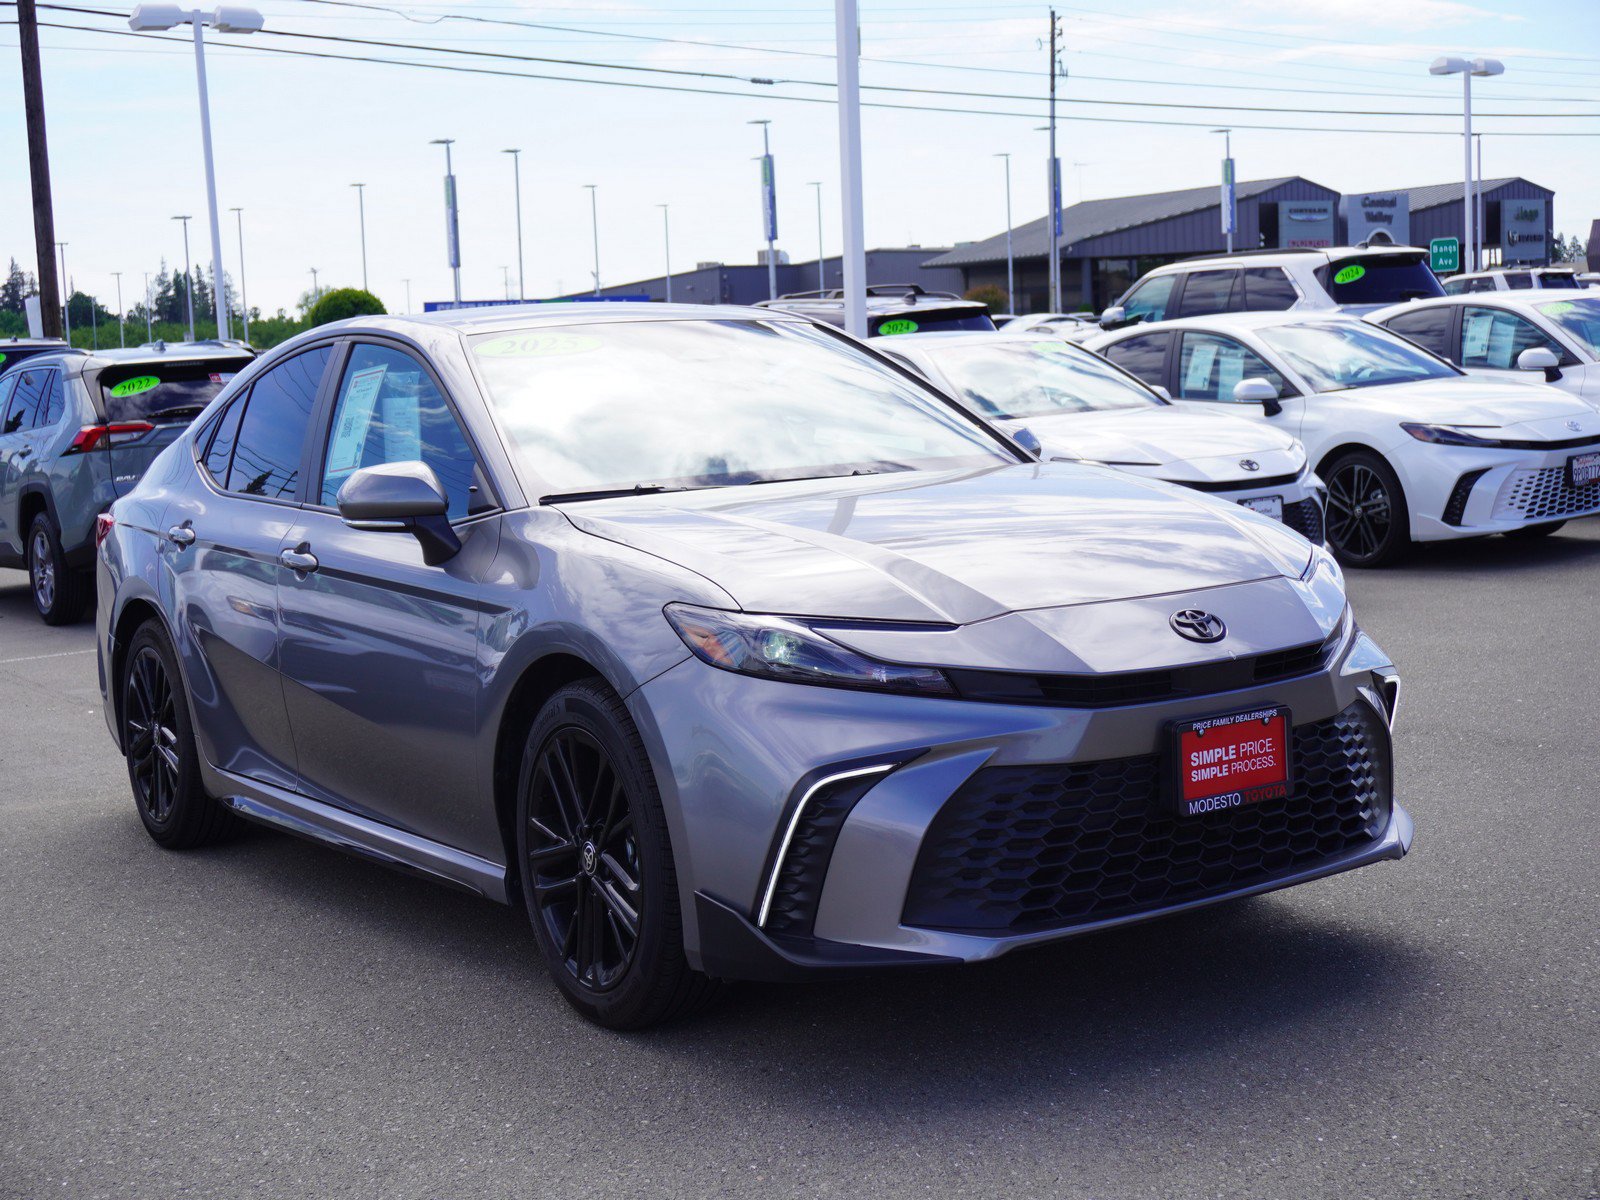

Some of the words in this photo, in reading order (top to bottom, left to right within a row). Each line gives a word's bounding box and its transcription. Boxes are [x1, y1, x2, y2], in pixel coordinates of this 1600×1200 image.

[1432, 244, 1457, 254] Bangs
[1438, 257, 1453, 266] Ave
[1340, 268, 1361, 283] 2024
[886, 320, 910, 334] 2024
[501, 336, 579, 354] 2025
[119, 378, 152, 397] 2022
[1192, 719, 1212, 731] PRICE
[1212, 716, 1235, 728] FAMILY
[1235, 709, 1278, 724] DEALERSHIPS
[1190, 745, 1237, 767] SIMPLE
[1239, 737, 1276, 758] PRICE.
[1191, 764, 1229, 782] SIMPLE
[1231, 755, 1277, 775] PROCESS.
[1188, 793, 1242, 815] MODESTO
[1243, 785, 1287, 803] TOYOTA
